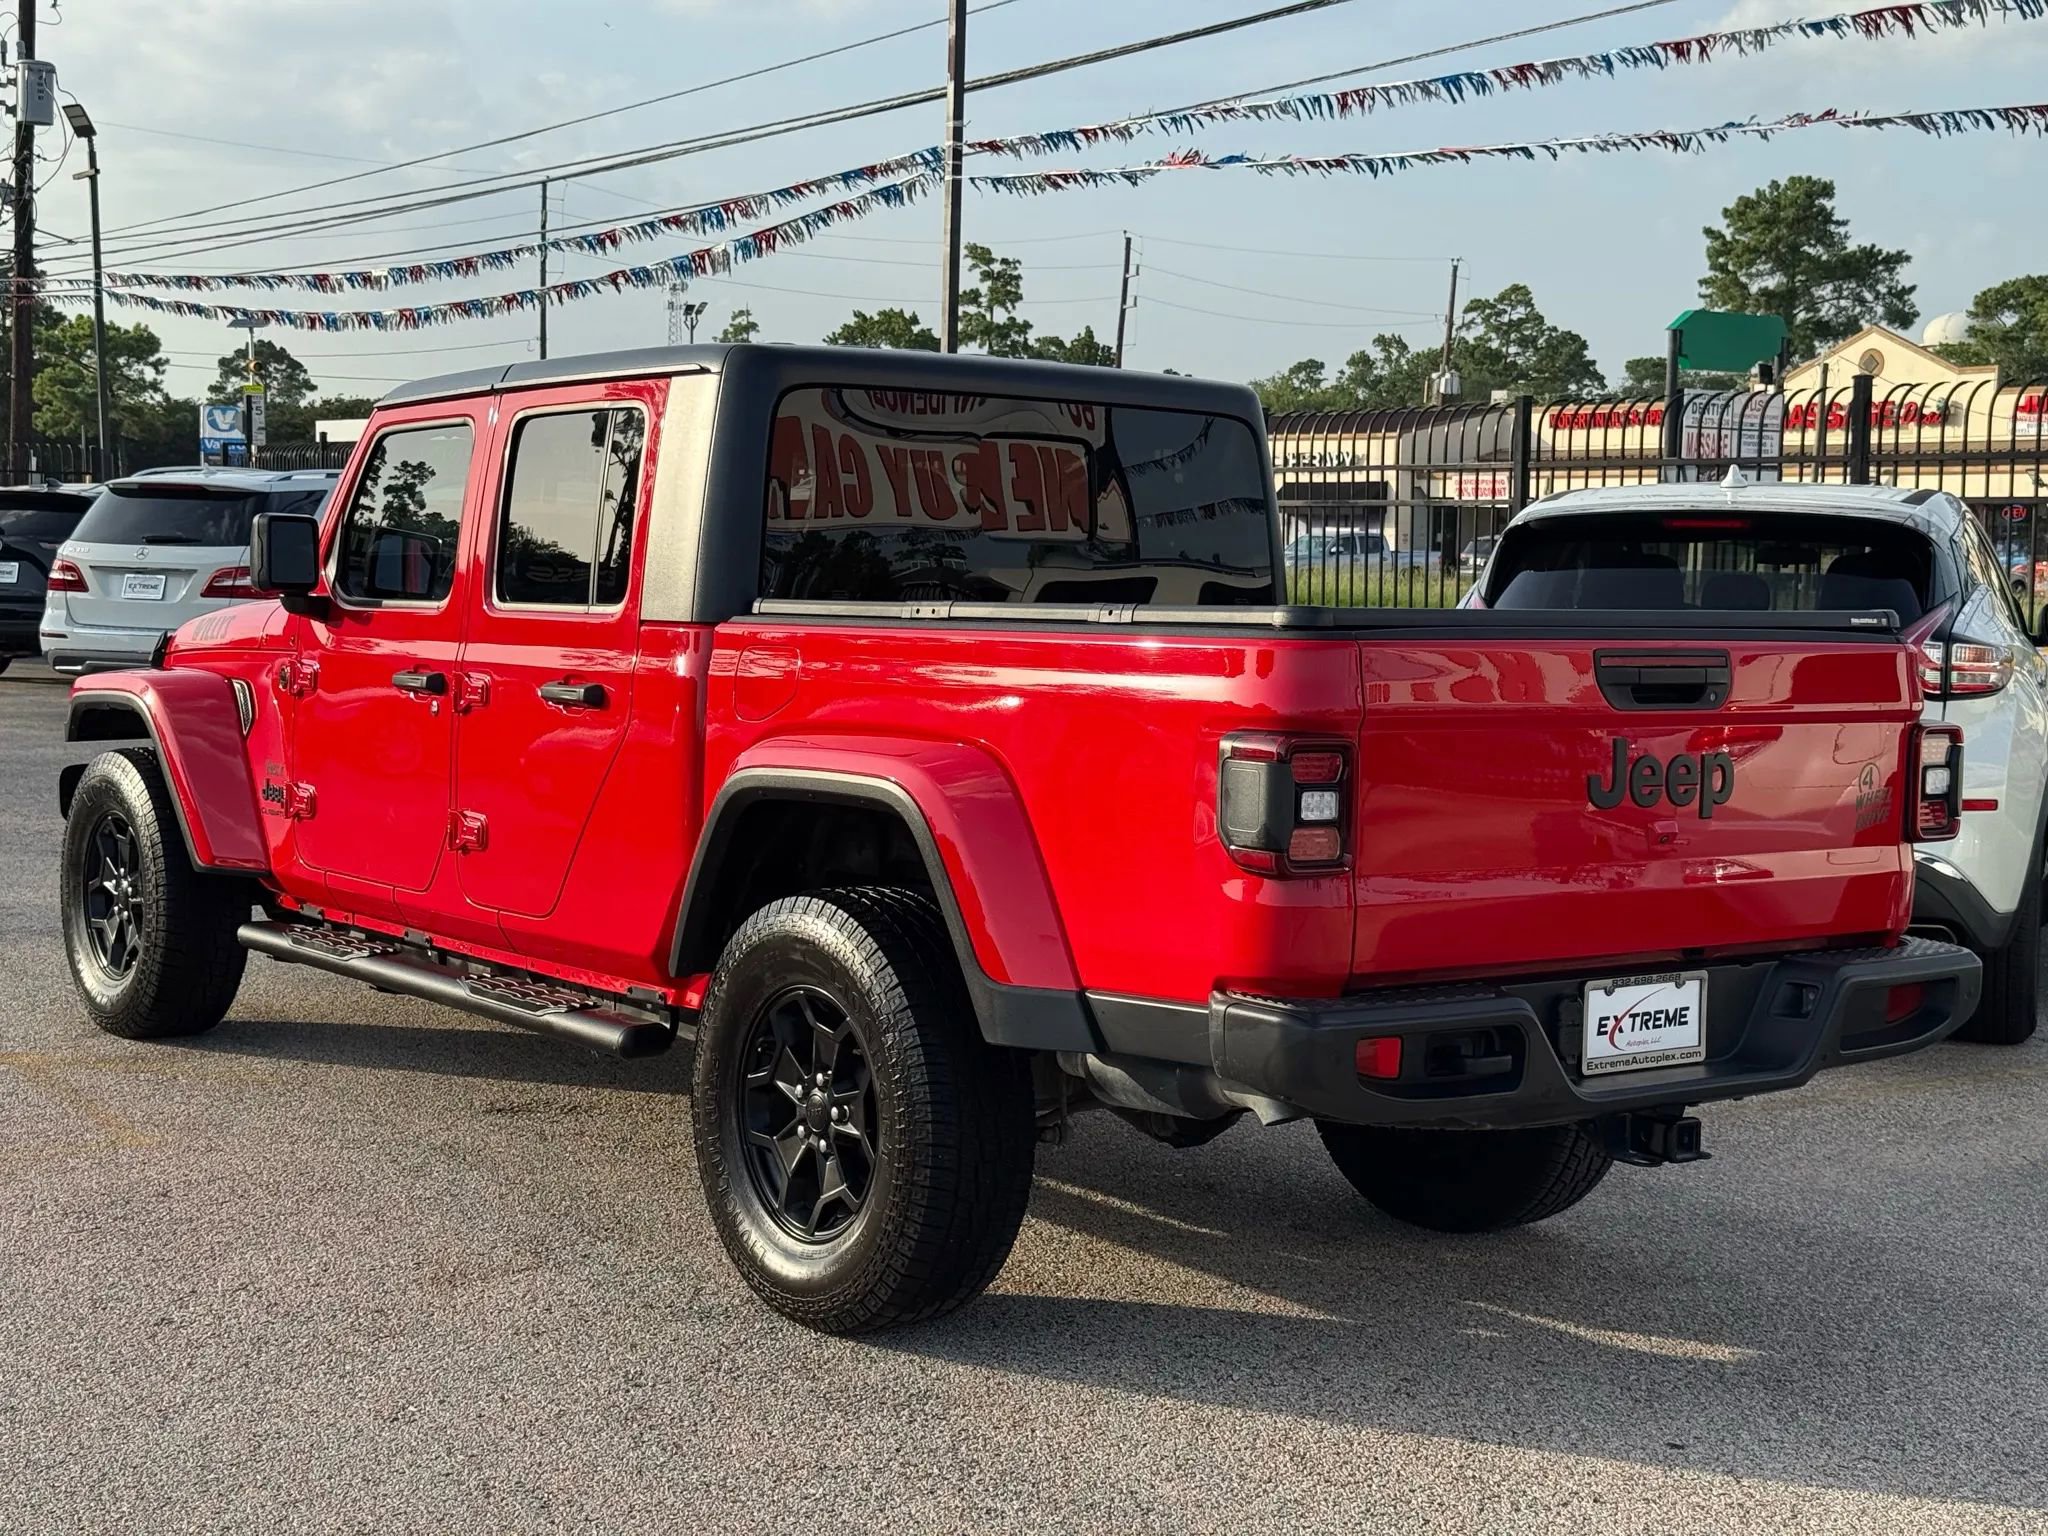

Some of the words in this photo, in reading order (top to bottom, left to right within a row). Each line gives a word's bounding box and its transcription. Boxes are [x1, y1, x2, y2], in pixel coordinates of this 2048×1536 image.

[1595, 411, 1628, 428] NILS
[1784, 402, 1896, 428] ASSE
[1685, 432, 1729, 458] MASSAE
[2001, 506, 2027, 520] OEN
[128, 583, 160, 591] EXTREME
[1587, 738, 1735, 819] Jeep
[1862, 766, 1873, 790] 4
[1597, 1006, 1690, 1036] EXTREME
[1586, 1050, 1702, 1072] ExtremeAutoplex.com
